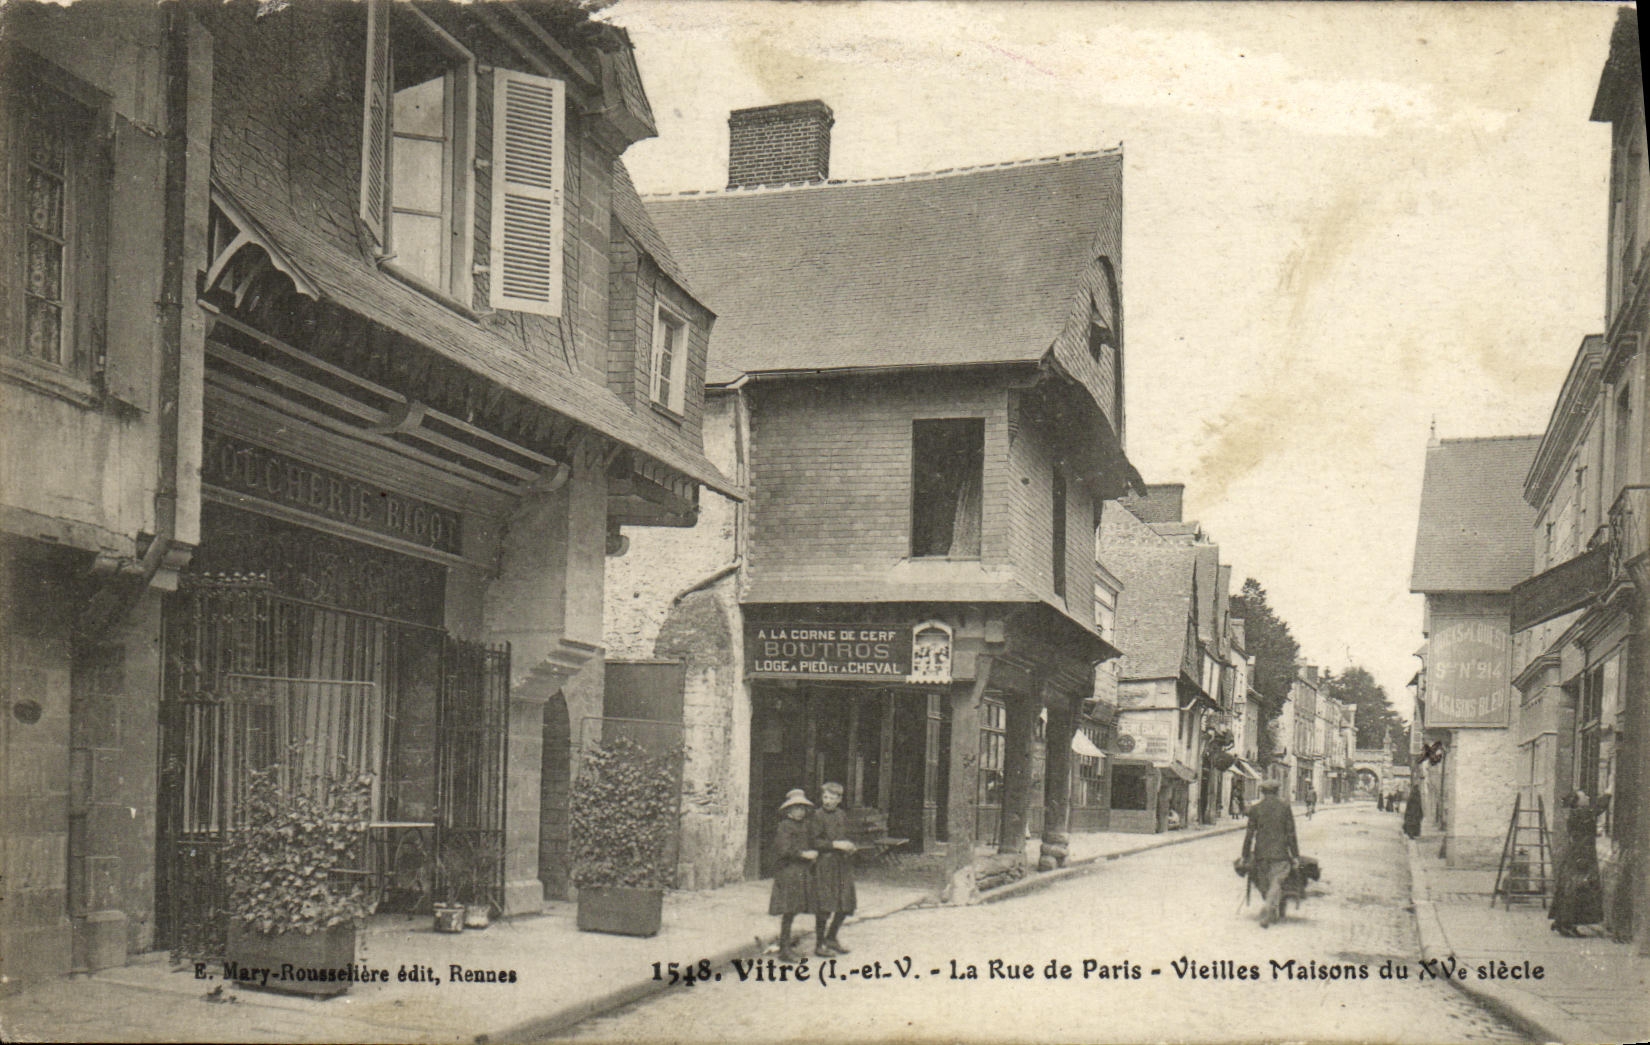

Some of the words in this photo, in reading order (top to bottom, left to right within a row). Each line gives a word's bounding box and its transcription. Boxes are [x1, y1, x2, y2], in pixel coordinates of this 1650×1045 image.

[204, 437, 373, 522] OUCHERIE
[758, 630, 766, 640] A
[770, 630, 786, 640] LA
[791, 630, 836, 641] CORNE
[840, 631, 856, 641] DE
[860, 631, 897, 641] CERF
[764, 642, 890, 658] BOUTROS
[755, 660, 792, 672] LOGE
[800, 661, 828, 673] PIED
[848, 662, 901, 674] CHEVAL
